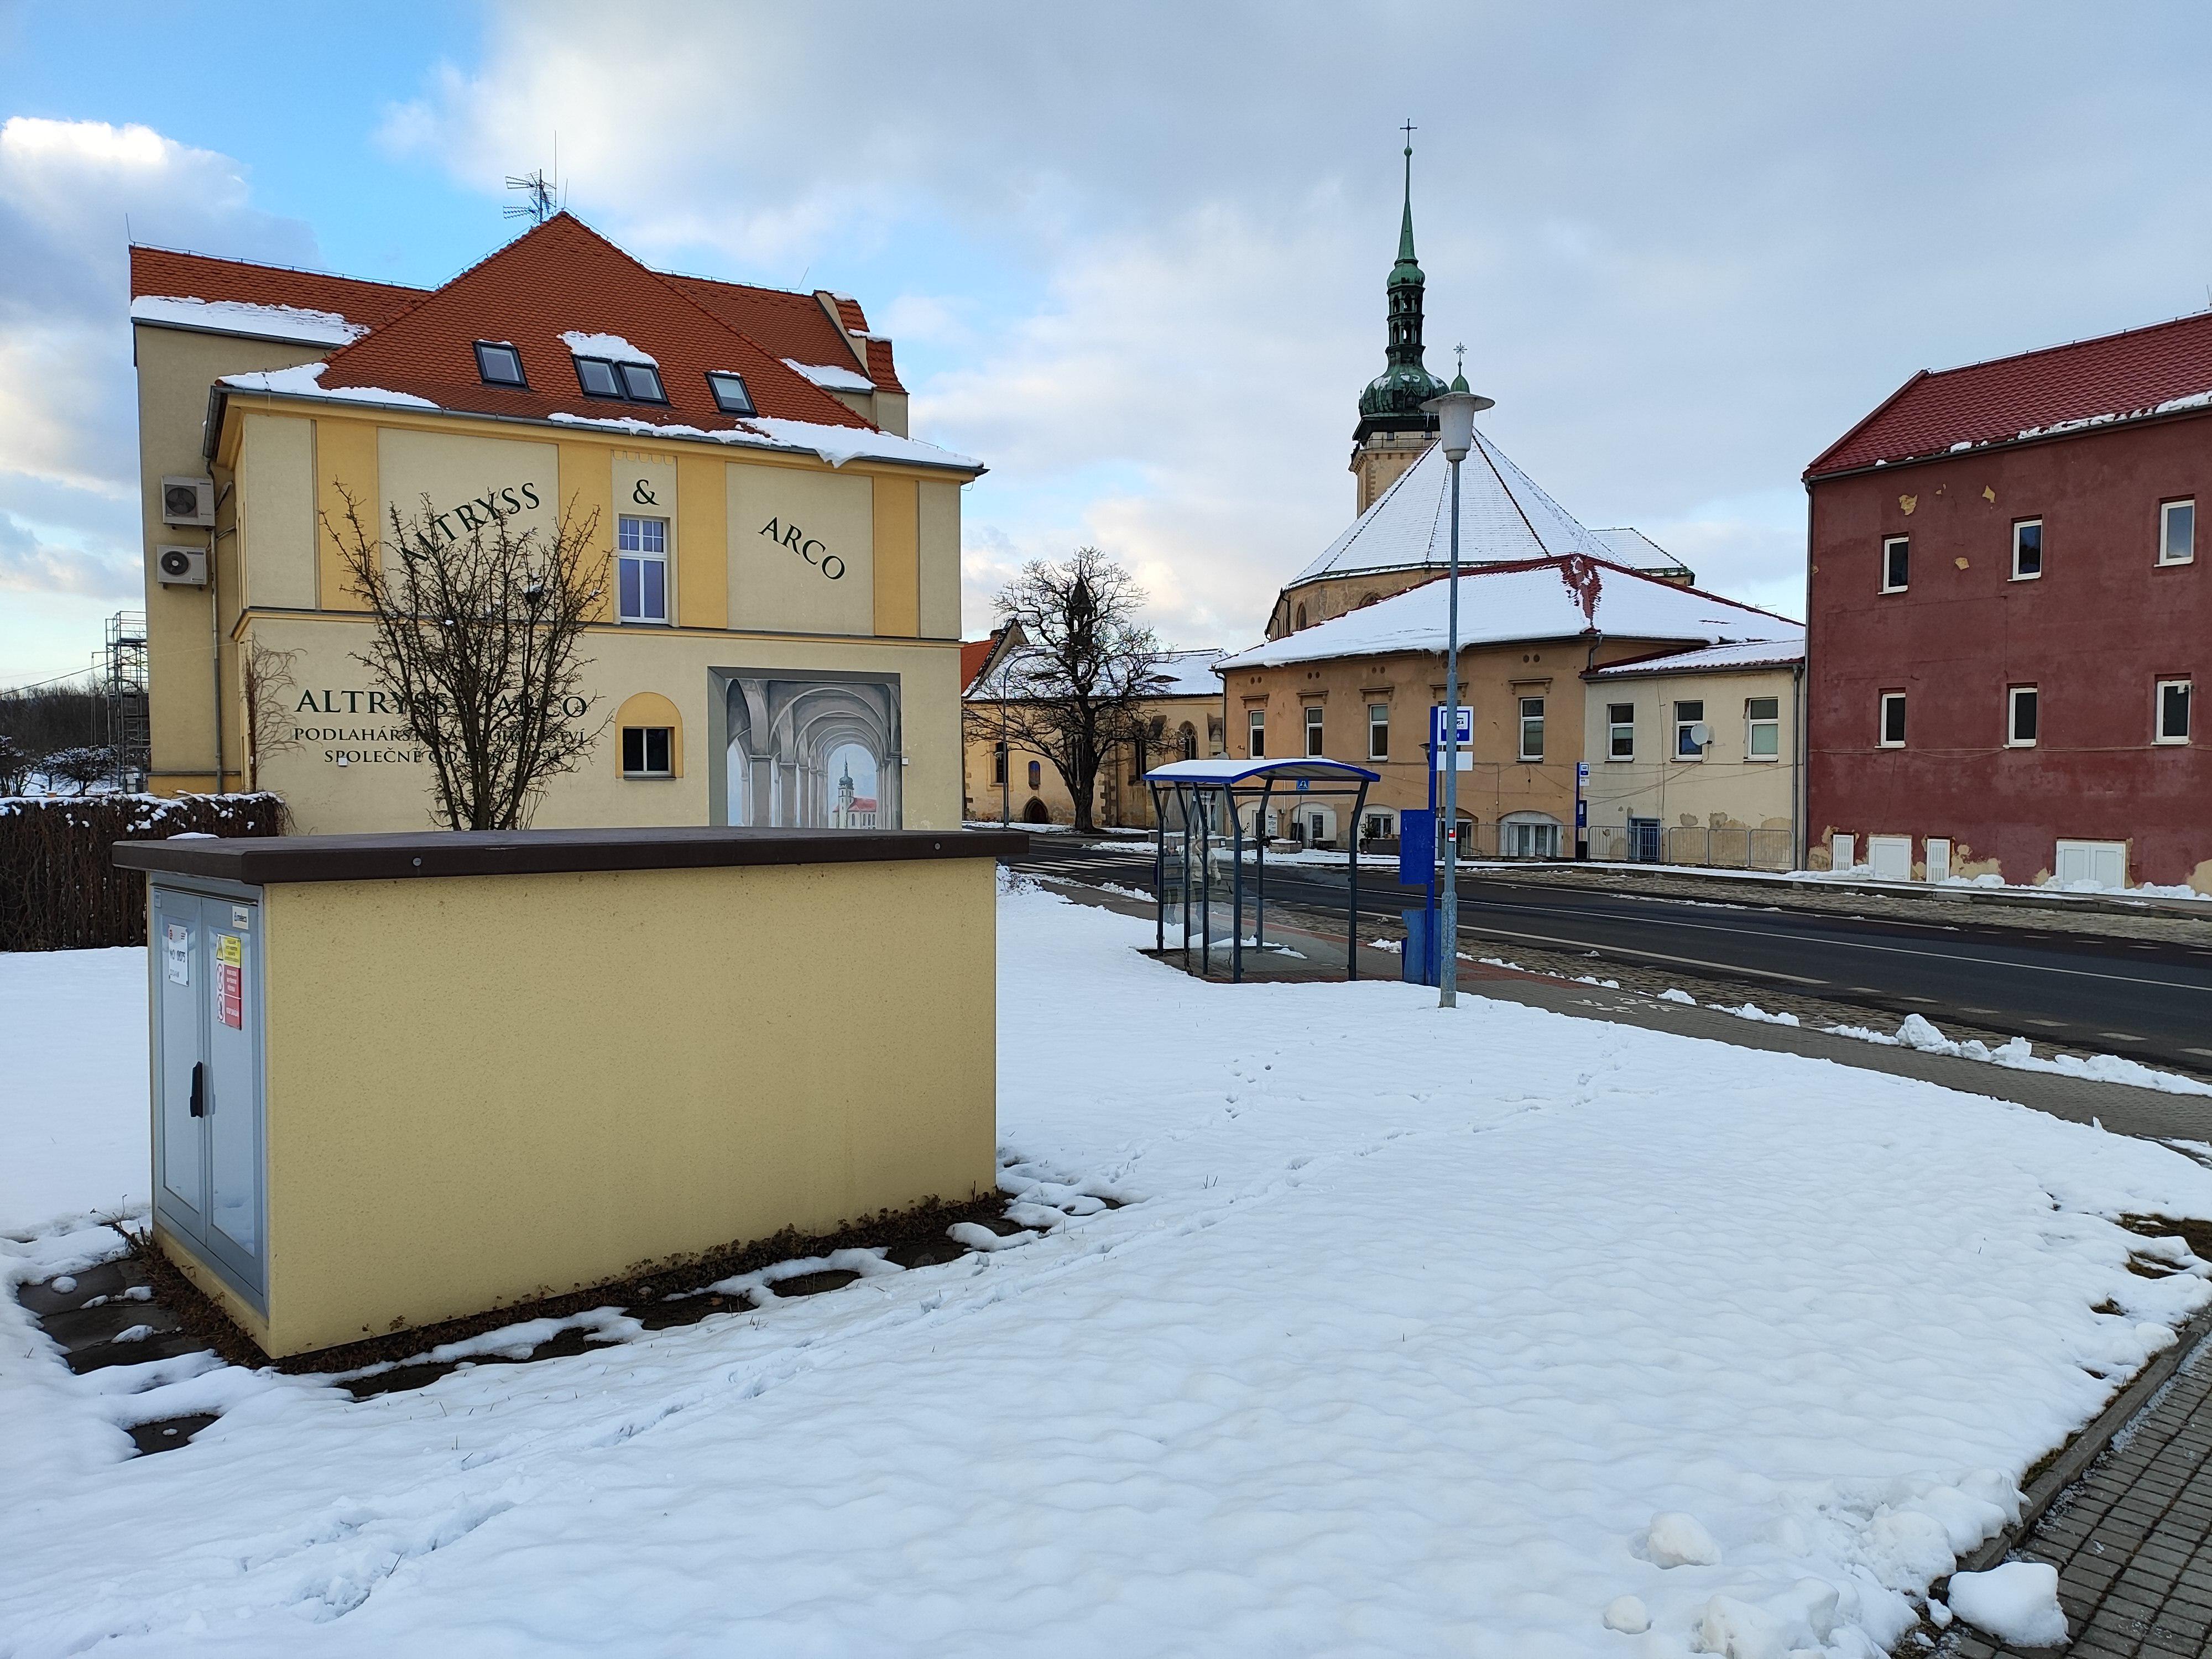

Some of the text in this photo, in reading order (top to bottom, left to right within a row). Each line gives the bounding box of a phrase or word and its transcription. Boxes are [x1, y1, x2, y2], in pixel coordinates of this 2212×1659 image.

[633, 479, 660, 506] &
[758, 517, 845, 580] ARCO
[294, 726, 441, 742] PODLAHÁŘS
